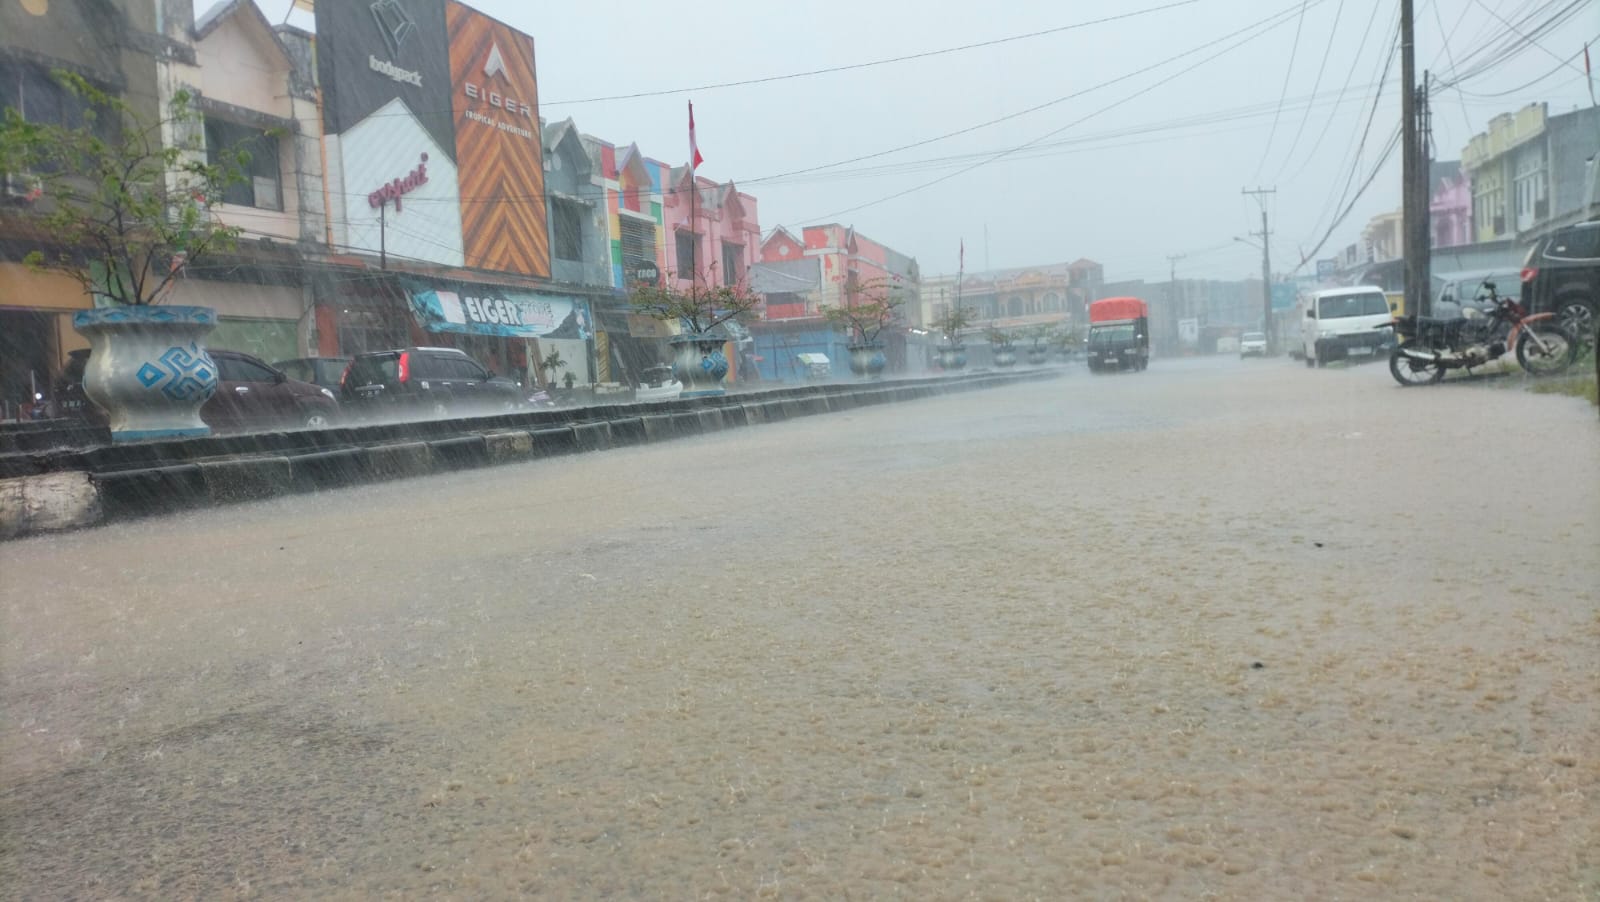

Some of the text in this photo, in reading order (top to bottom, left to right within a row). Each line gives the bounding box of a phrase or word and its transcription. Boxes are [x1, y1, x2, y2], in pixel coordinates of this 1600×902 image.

[465, 82, 531, 117] EIGER
[466, 110, 532, 139] TROPICAL ADVENTURE
[464, 296, 522, 326] EIGER
